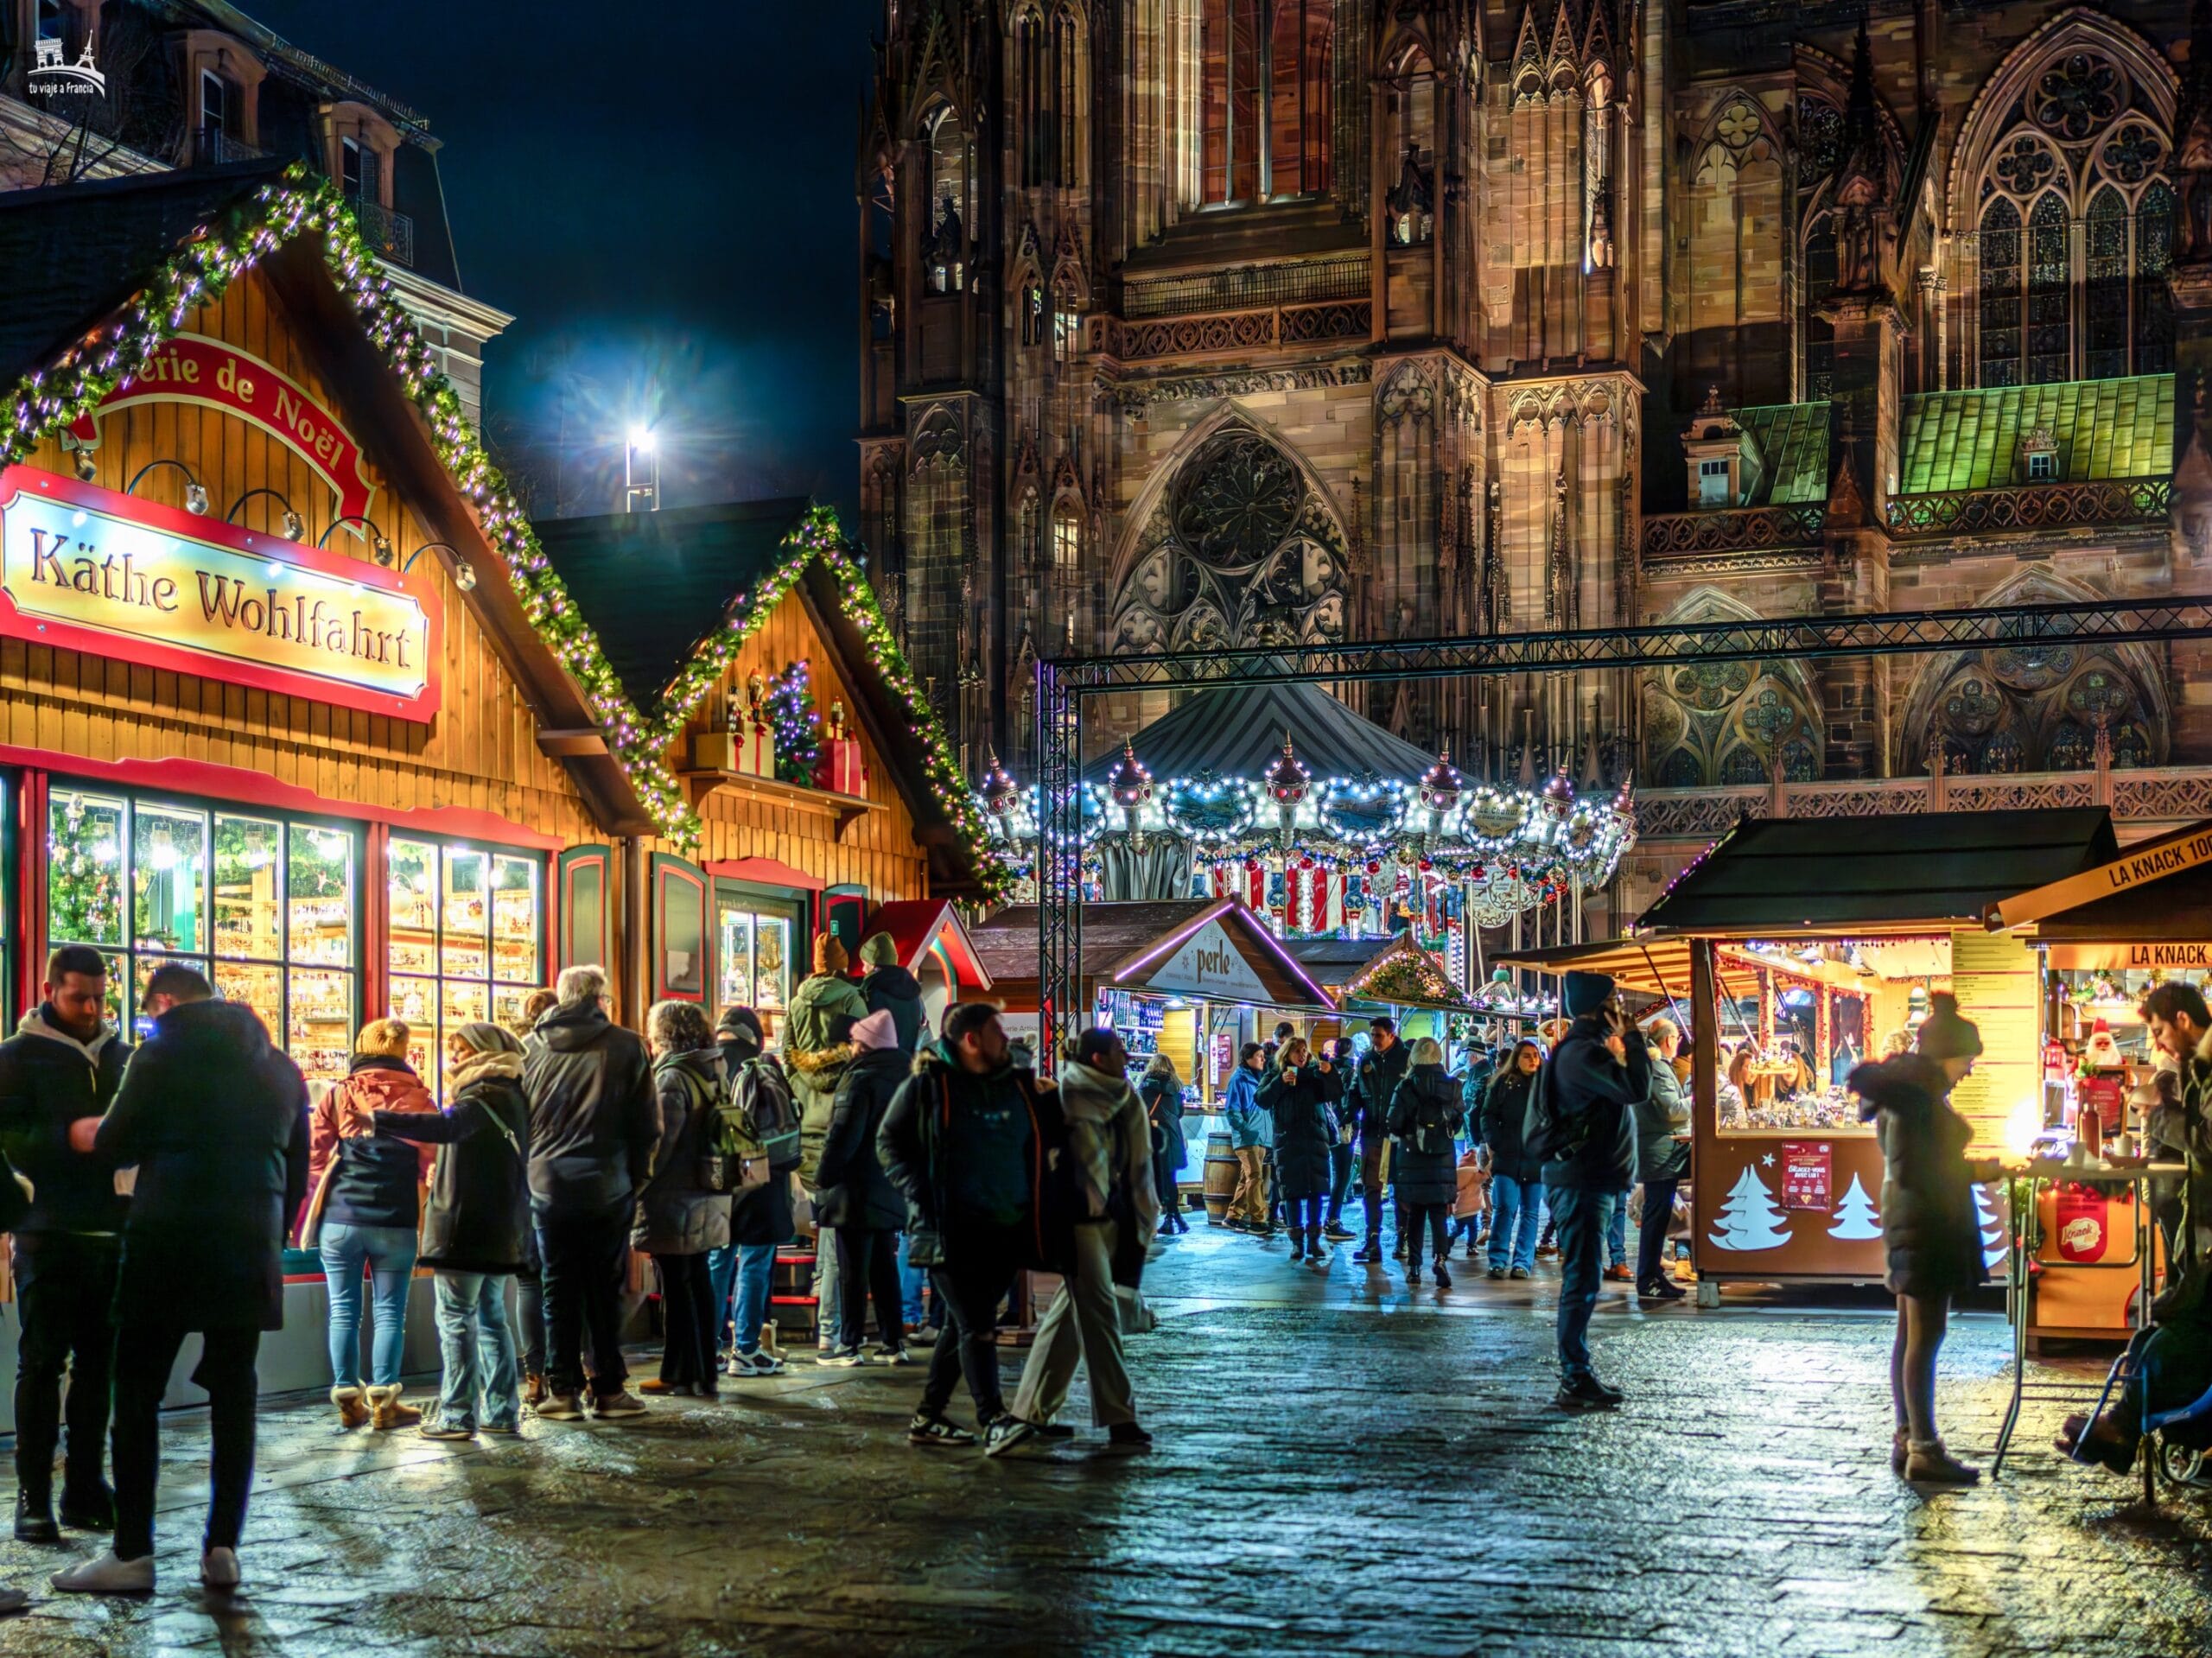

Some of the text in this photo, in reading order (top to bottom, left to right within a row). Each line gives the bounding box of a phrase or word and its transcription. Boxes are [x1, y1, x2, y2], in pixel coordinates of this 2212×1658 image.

[137, 348, 345, 471] erie de Noël
[29, 527, 411, 670] Käthe Wohlfahrt
[2108, 865, 2131, 888] LA
[2132, 847, 2186, 880] KNACK
[1197, 938, 1230, 984] perle
[2132, 944, 2207, 965] LA KNACK
